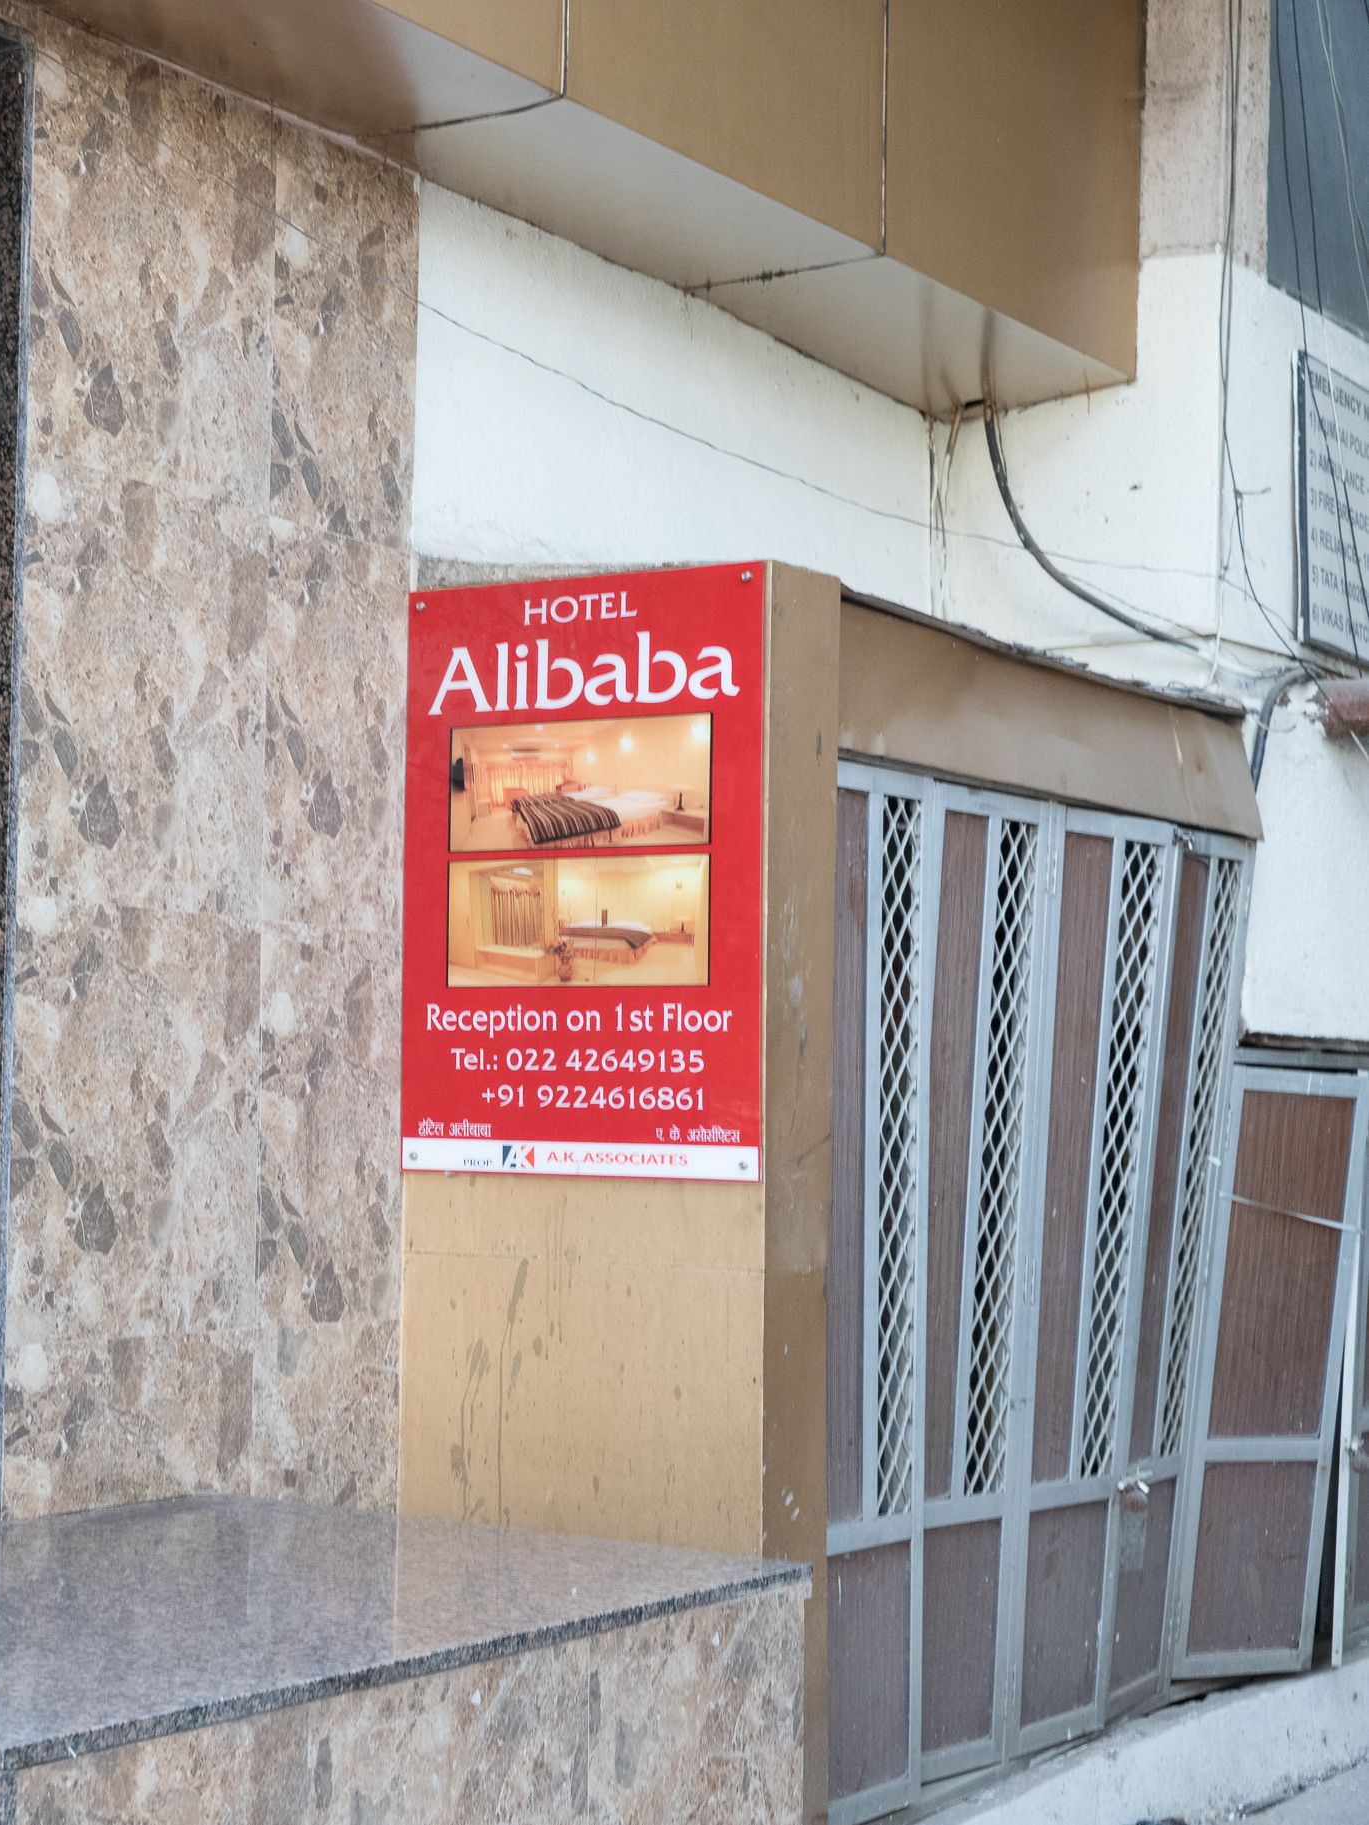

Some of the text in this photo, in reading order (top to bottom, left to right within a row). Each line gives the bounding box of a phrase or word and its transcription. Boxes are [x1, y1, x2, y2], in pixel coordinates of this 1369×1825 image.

[1319, 489, 1335, 517] FIRE
[1337, 500, 1369, 534] BRGADE
[1320, 529, 1359, 566] RELIACE
[1321, 567, 1338, 593] TATA
[523, 591, 638, 626] HOTEL
[1321, 605, 1344, 632] VIKAS
[428, 630, 740, 716] Alibaba
[426, 1002, 734, 1039] Reception on 1st Floor
[450, 1047, 706, 1074] Tel.: 022 42649135
[481, 1083, 704, 1112] +91 9224616861
[582, 1152, 689, 1166] ASSOCIATES
